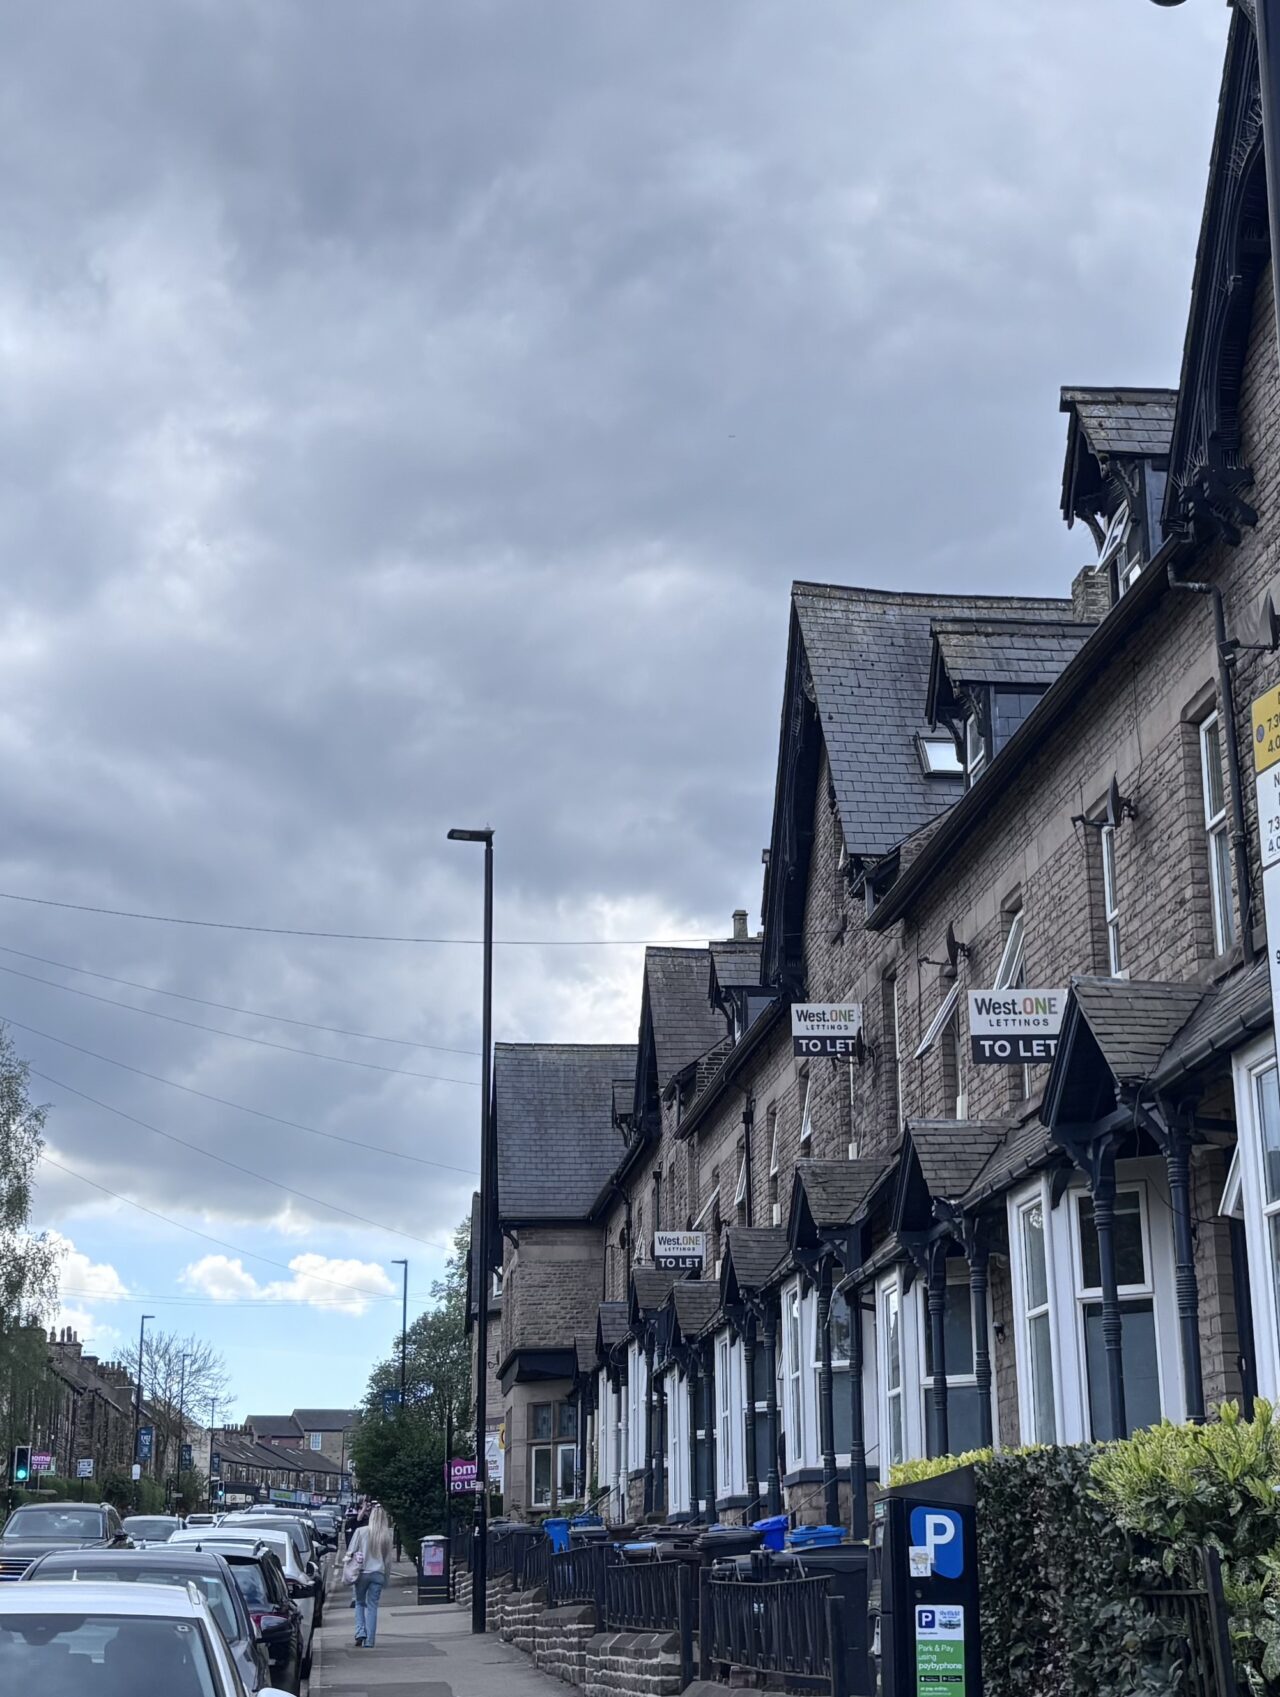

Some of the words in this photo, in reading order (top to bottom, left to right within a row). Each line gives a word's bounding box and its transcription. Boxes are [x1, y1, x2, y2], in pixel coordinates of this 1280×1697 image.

[974, 998, 1058, 1015] West.ONE
[796, 1009, 855, 1022] West.ONE
[989, 1018, 1049, 1026] LETTINGS
[798, 1040, 821, 1052] TO
[826, 1040, 854, 1052] LET
[980, 1040, 1011, 1056] TO
[1019, 1040, 1058, 1056] LET
[658, 1236, 700, 1246] West.ONE
[660, 1258, 676, 1268] TO
[680, 1258, 700, 1268] LET
[926, 1514, 956, 1564] P
[922, 1612, 932, 1626] P
[941, 1644, 954, 1653] Pay
[918, 1662, 962, 1670] paybyphone
